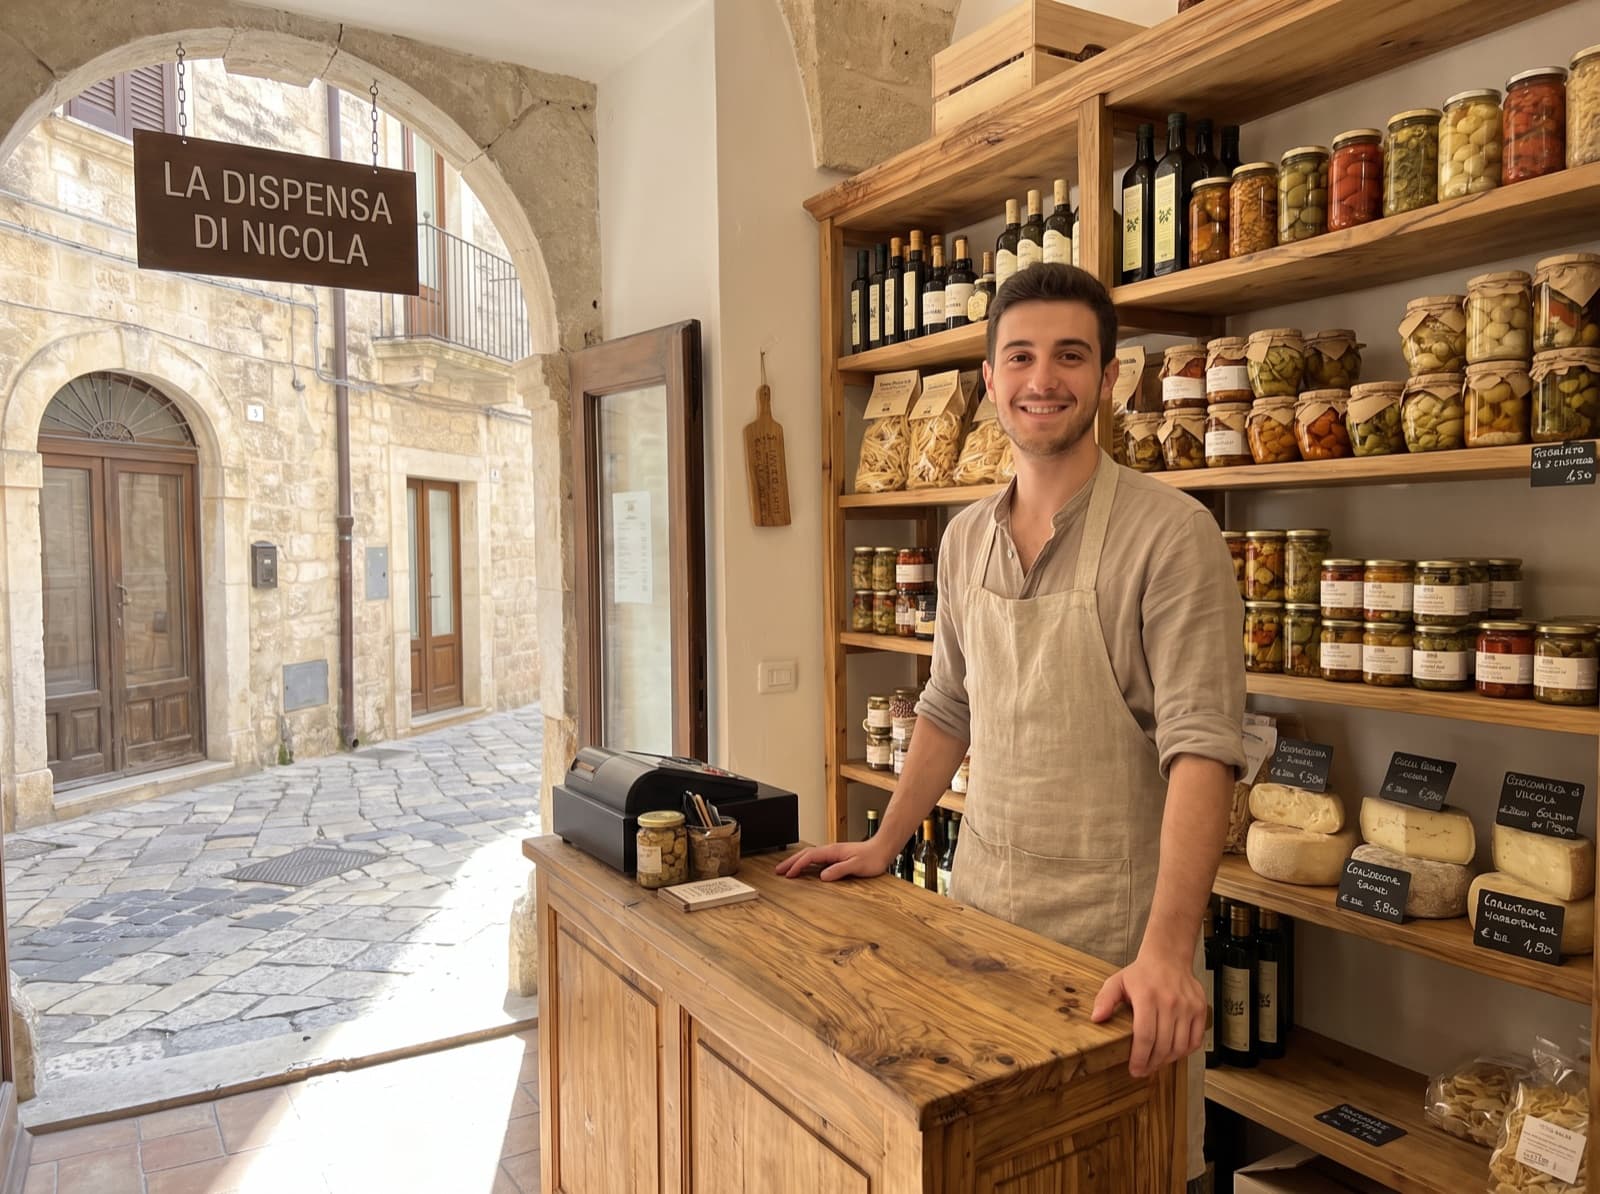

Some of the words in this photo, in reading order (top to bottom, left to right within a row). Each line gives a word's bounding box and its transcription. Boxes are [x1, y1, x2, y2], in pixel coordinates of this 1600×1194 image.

[164, 161, 211, 201] LA
[223, 169, 393, 225] DISPENSA
[194, 213, 229, 251] DI
[242, 219, 369, 267] NICOLA
